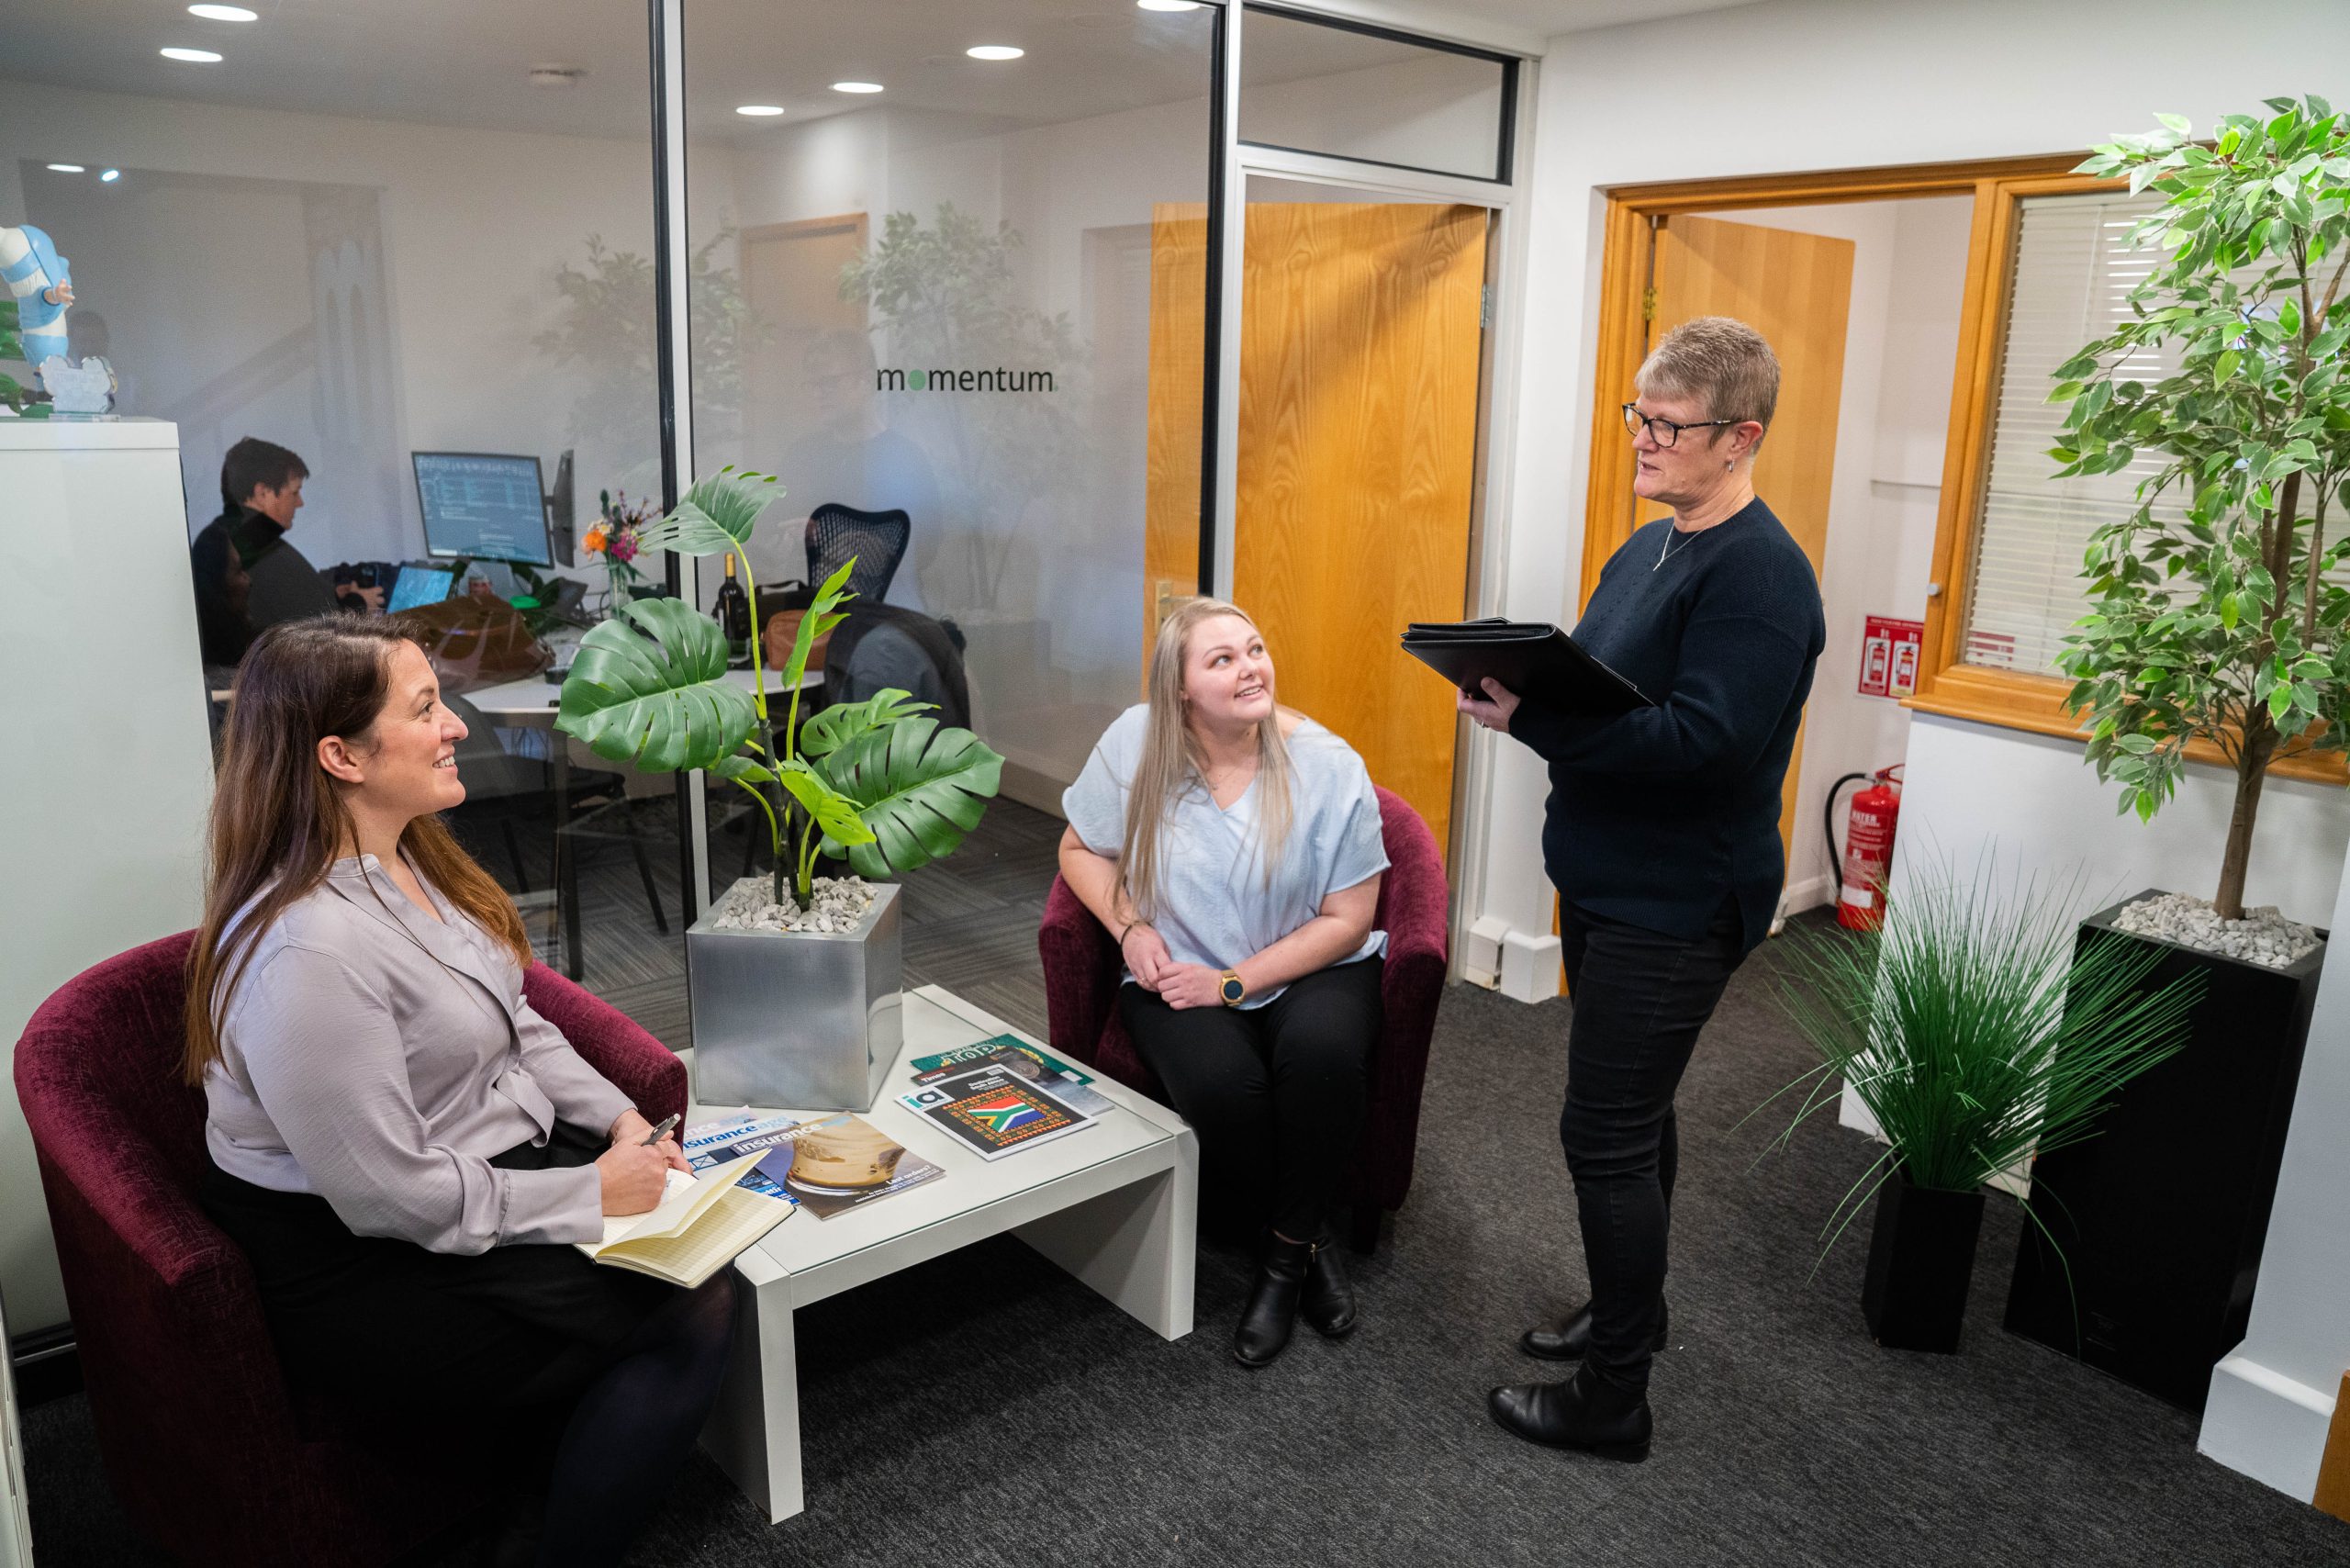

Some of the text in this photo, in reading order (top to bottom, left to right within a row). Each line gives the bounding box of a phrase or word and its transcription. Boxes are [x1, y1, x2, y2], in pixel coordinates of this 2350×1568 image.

[901, 1091, 946, 1109] ia
[733, 1123, 823, 1154] insurance
[886, 1165, 931, 1185] Last orders?
